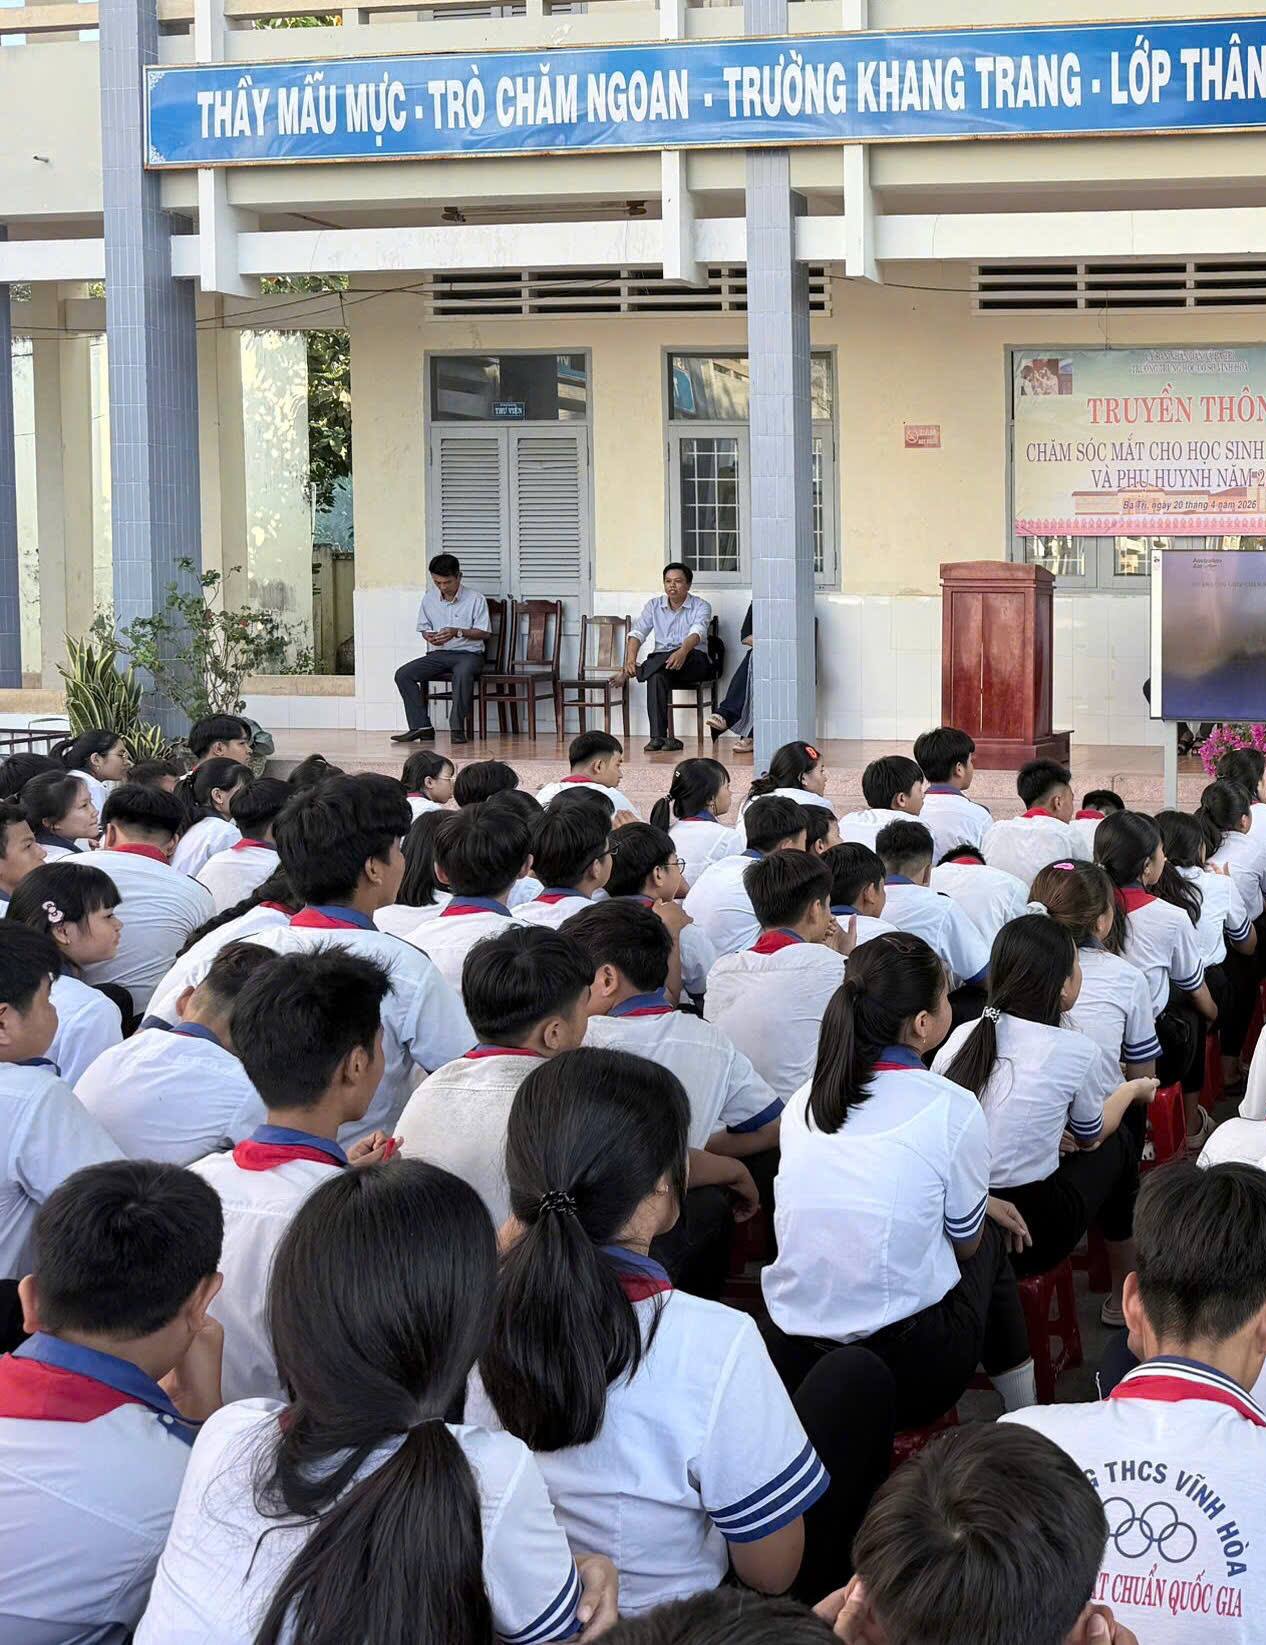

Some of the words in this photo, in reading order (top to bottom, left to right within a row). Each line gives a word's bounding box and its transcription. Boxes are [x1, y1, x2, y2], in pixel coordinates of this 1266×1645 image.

[198, 78, 272, 138] THẦY
[278, 71, 337, 135] MẪU
[346, 71, 407, 147] MỰC
[427, 66, 485, 130] TRÒ
[497, 66, 578, 127] CHĂM
[587, 69, 689, 123] NGOAN
[722, 49, 846, 119] TRƯỜNG
[856, 57, 965, 113] KHANG
[975, 53, 1082, 110] TRANG
[1110, 34, 1171, 106] LỚP
[1087, 383, 1194, 424] TRUYỀN
[1026, 439, 1072, 462] CHĂM
[1076, 437, 1107, 462] SÓC
[1111, 433, 1145, 462] MẮT
[1149, 440, 1183, 461] CHO
[1187, 440, 1221, 465] HỌC
[1091, 464, 1112, 488] VÀ
[1155, 468, 1211, 488] HUYNH
[1216, 464, 1252, 488] NĂM
[1173, 500, 1183, 509] 20
[1237, 500, 1257, 509] 2026
[1104, 1460, 1168, 1484] THCS
[1175, 1469, 1226, 1520] VĨNH
[1216, 1520, 1248, 1577] HÒA
[1111, 1563, 1166, 1608] CHUẨN
[1168, 1570, 1214, 1616] QUỐC
[1216, 1586, 1243, 1618] GIA
